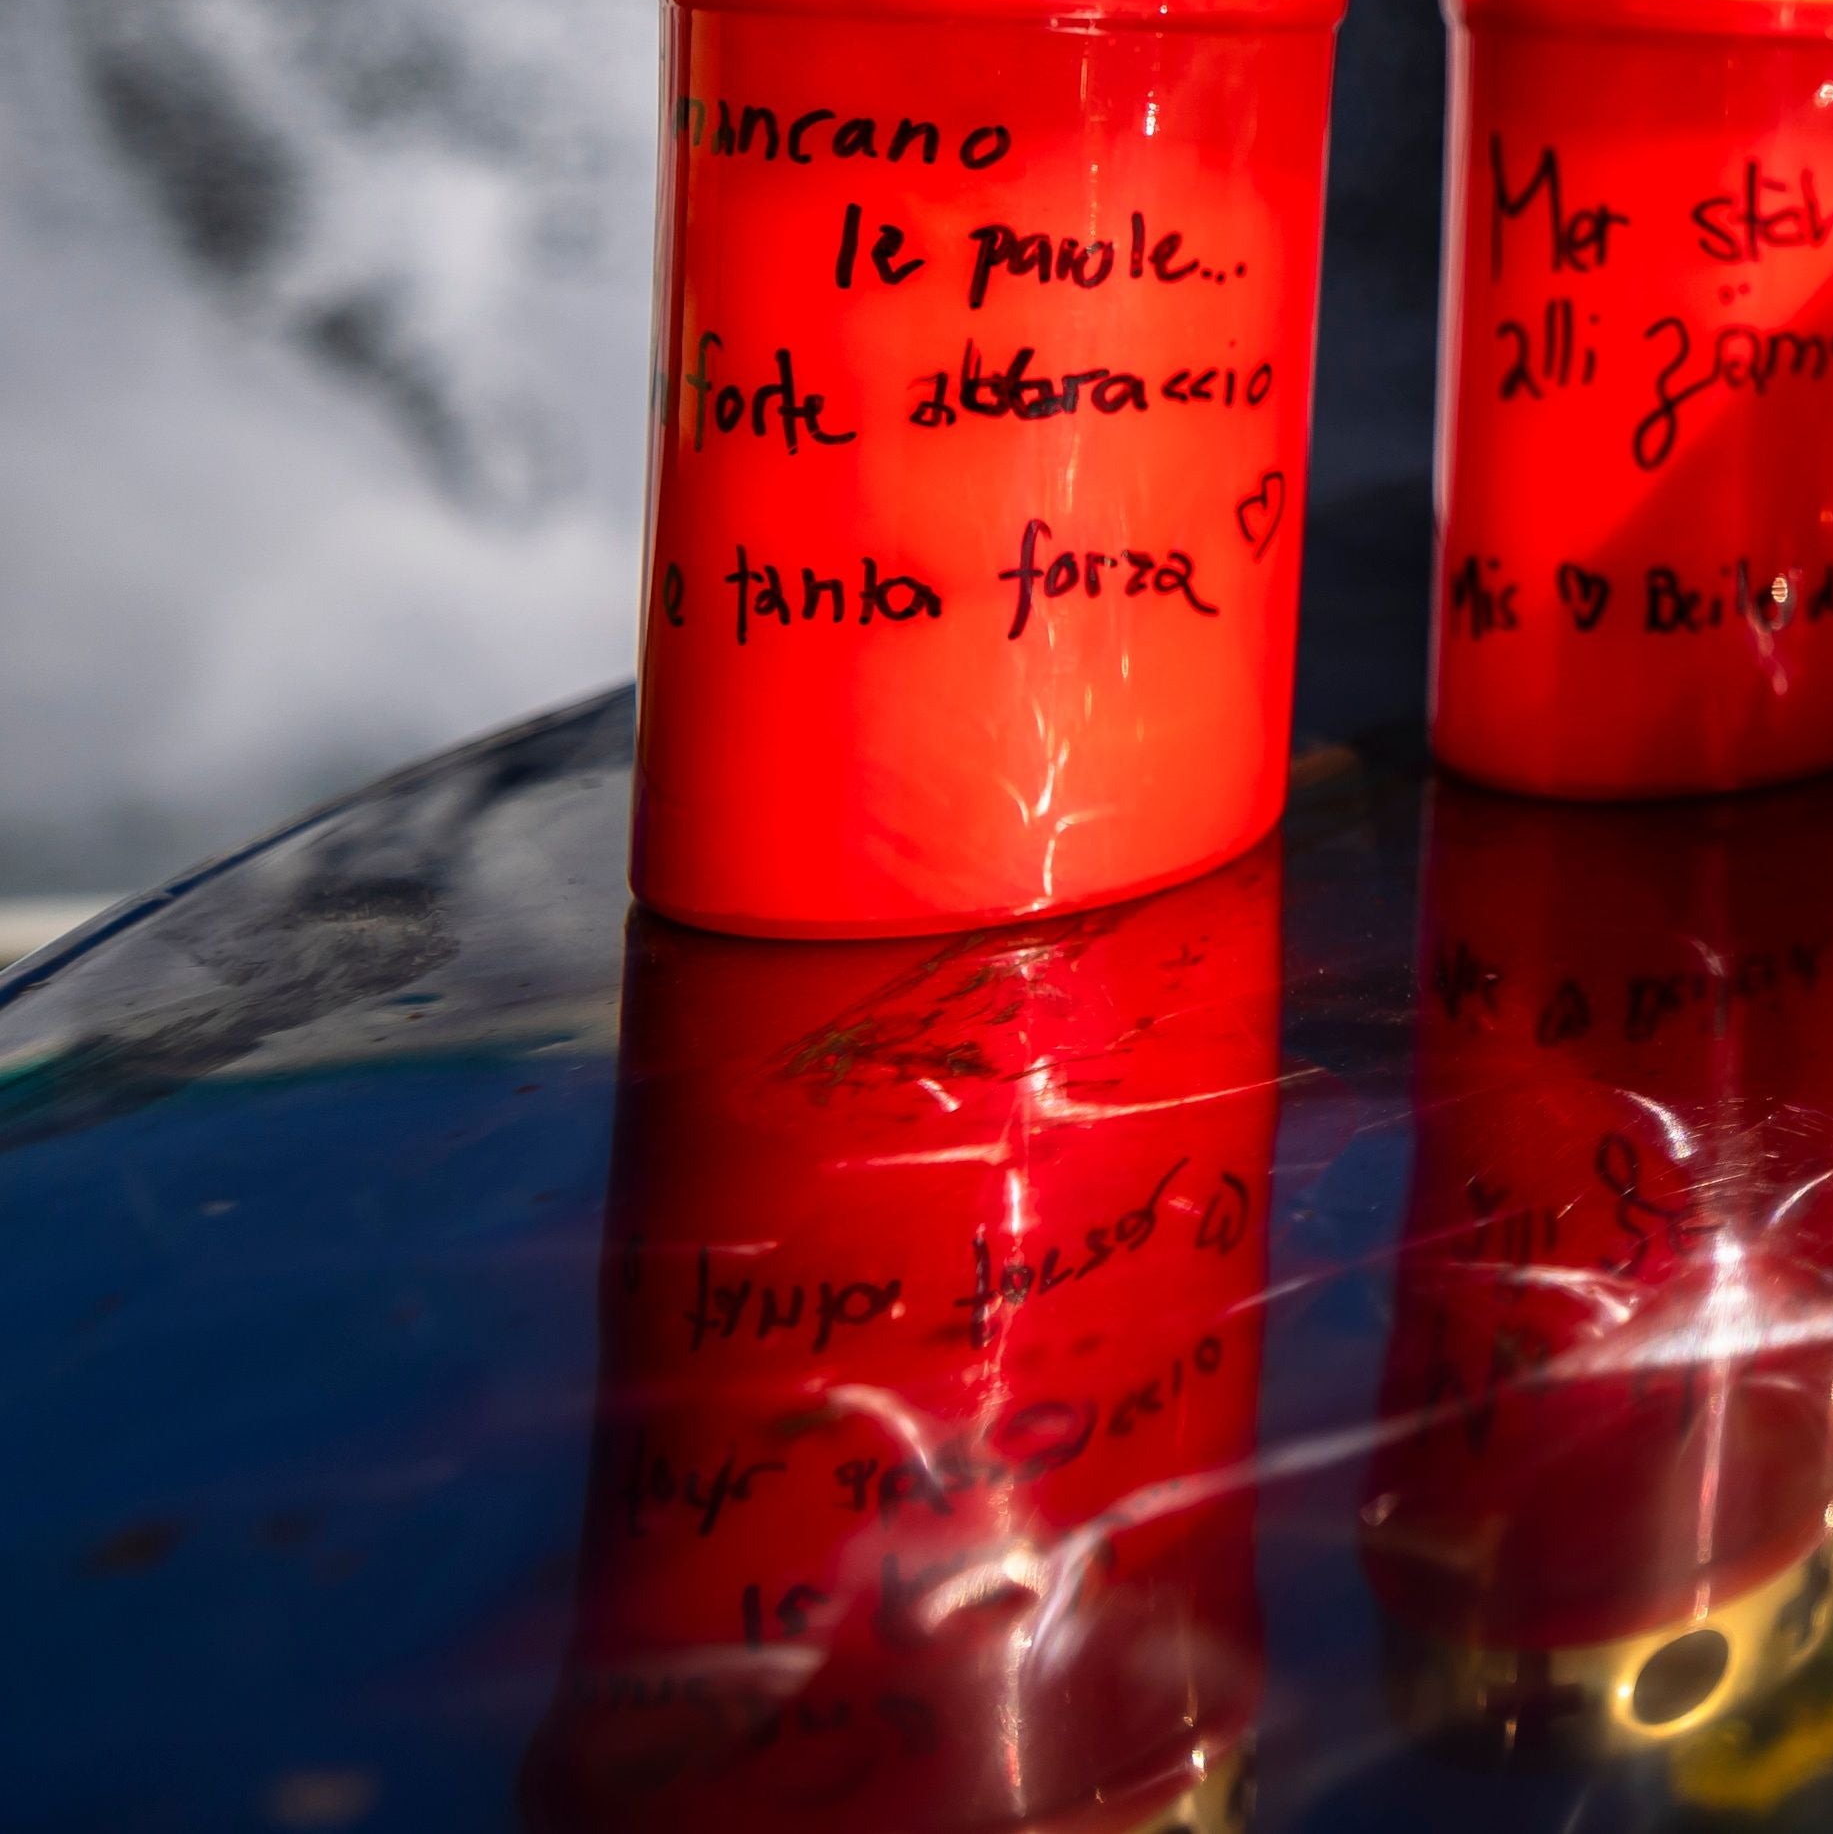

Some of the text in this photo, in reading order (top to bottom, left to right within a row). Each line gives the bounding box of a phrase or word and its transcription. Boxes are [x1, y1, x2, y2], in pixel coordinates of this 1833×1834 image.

[835, 202, 925, 289] le
[685, 329, 858, 456] forte
[723, 544, 943, 646] tanta
[997, 518, 1221, 641] forza
